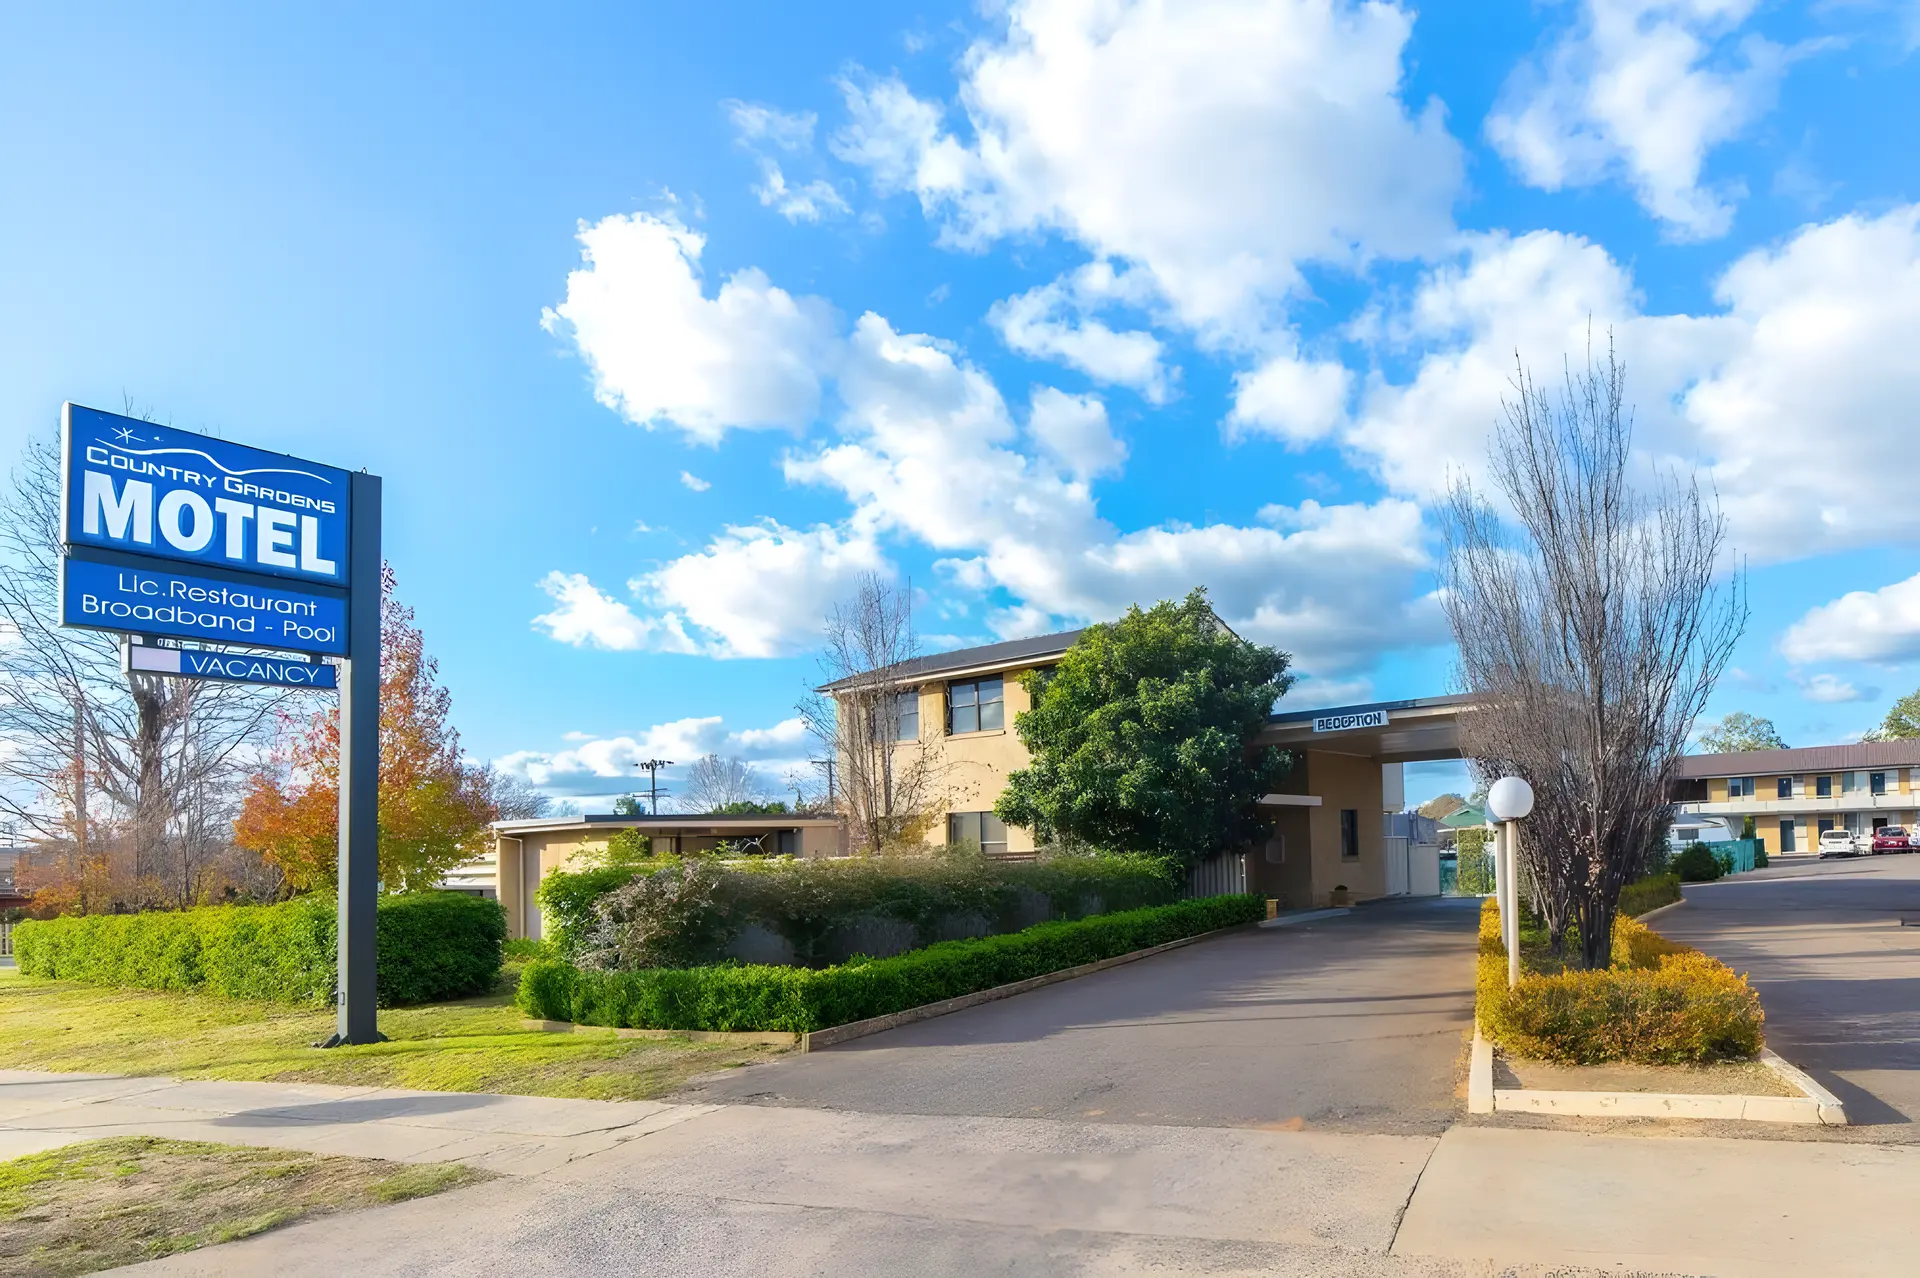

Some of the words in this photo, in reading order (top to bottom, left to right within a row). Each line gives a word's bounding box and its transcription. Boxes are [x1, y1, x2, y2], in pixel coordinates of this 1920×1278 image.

[86, 446, 217, 488] COUNTRY
[223, 476, 336, 514] GARDENS
[83, 469, 336, 576] MOTEL
[82, 593, 256, 633] Broadband
[282, 619, 336, 643] Pool
[189, 655, 320, 684] VACANCY
